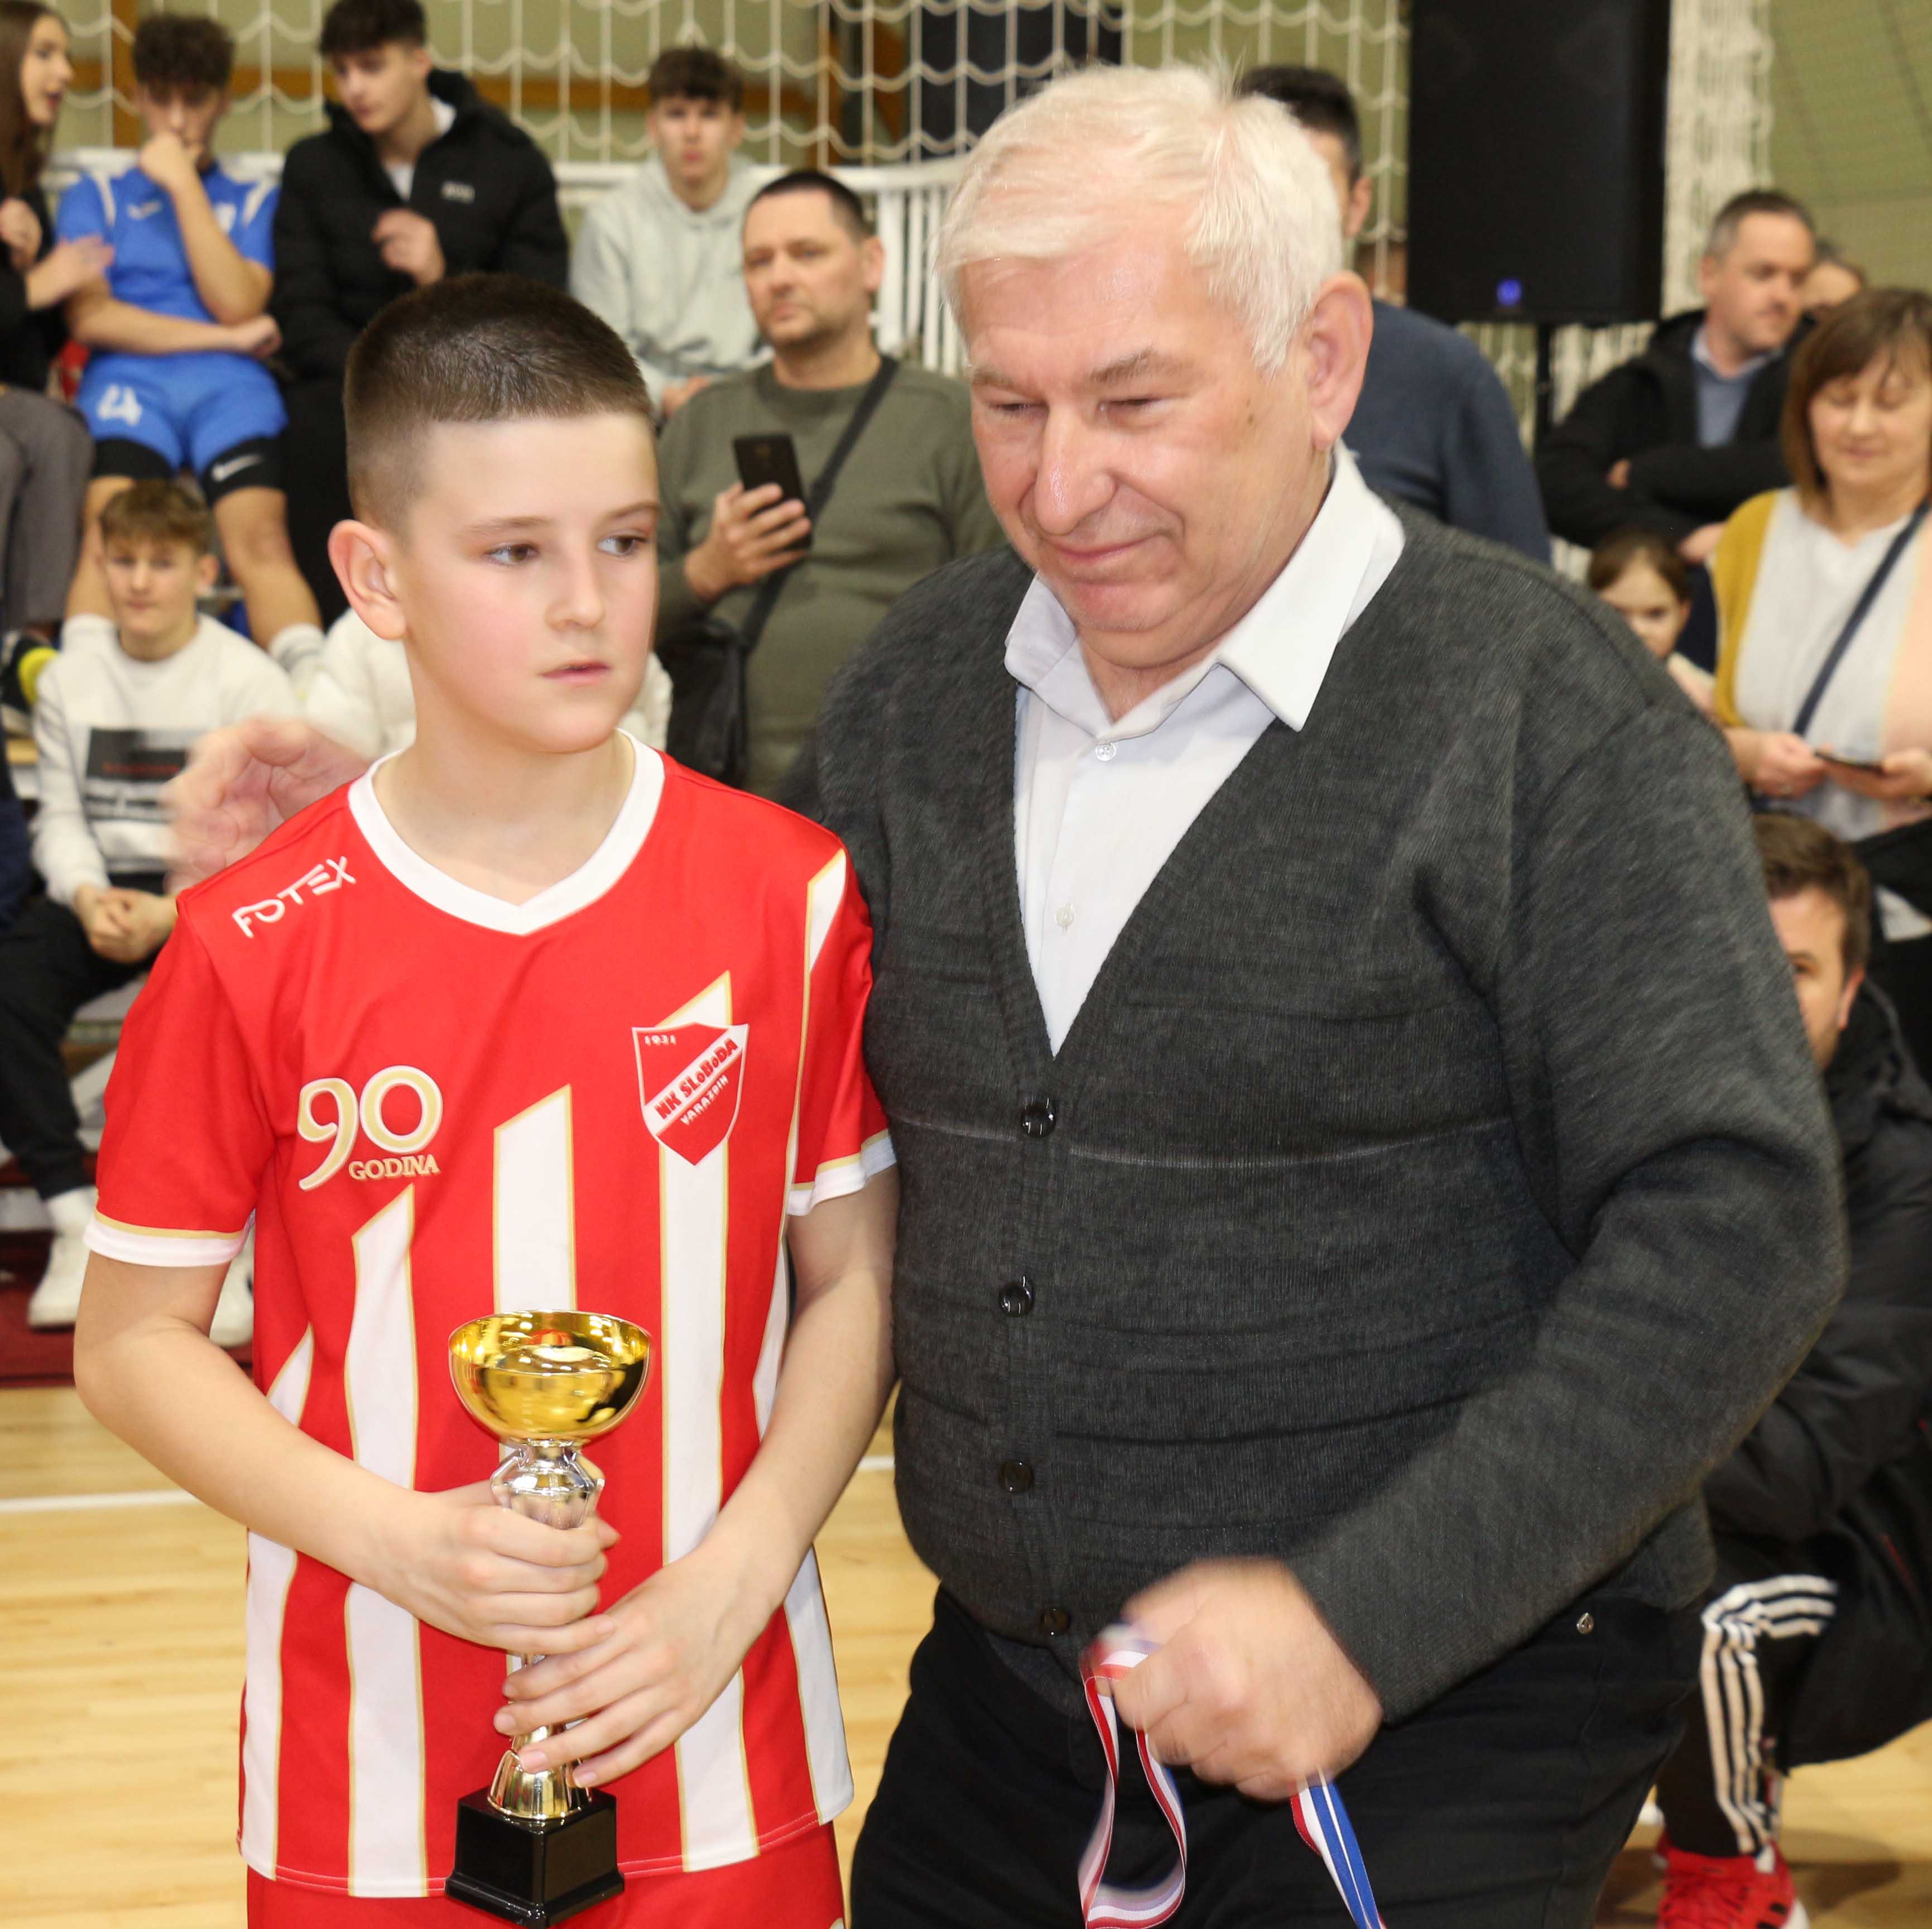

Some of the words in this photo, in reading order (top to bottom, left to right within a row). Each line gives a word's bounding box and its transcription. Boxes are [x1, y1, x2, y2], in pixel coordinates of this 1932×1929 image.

[97, 383, 143, 426] 4
[232, 856, 357, 938] FOTEX
[644, 1034, 677, 1046] 1931
[653, 1090, 682, 1120] NK
[297, 1064, 444, 1191] 90
[348, 1154, 441, 1180] GODINA
